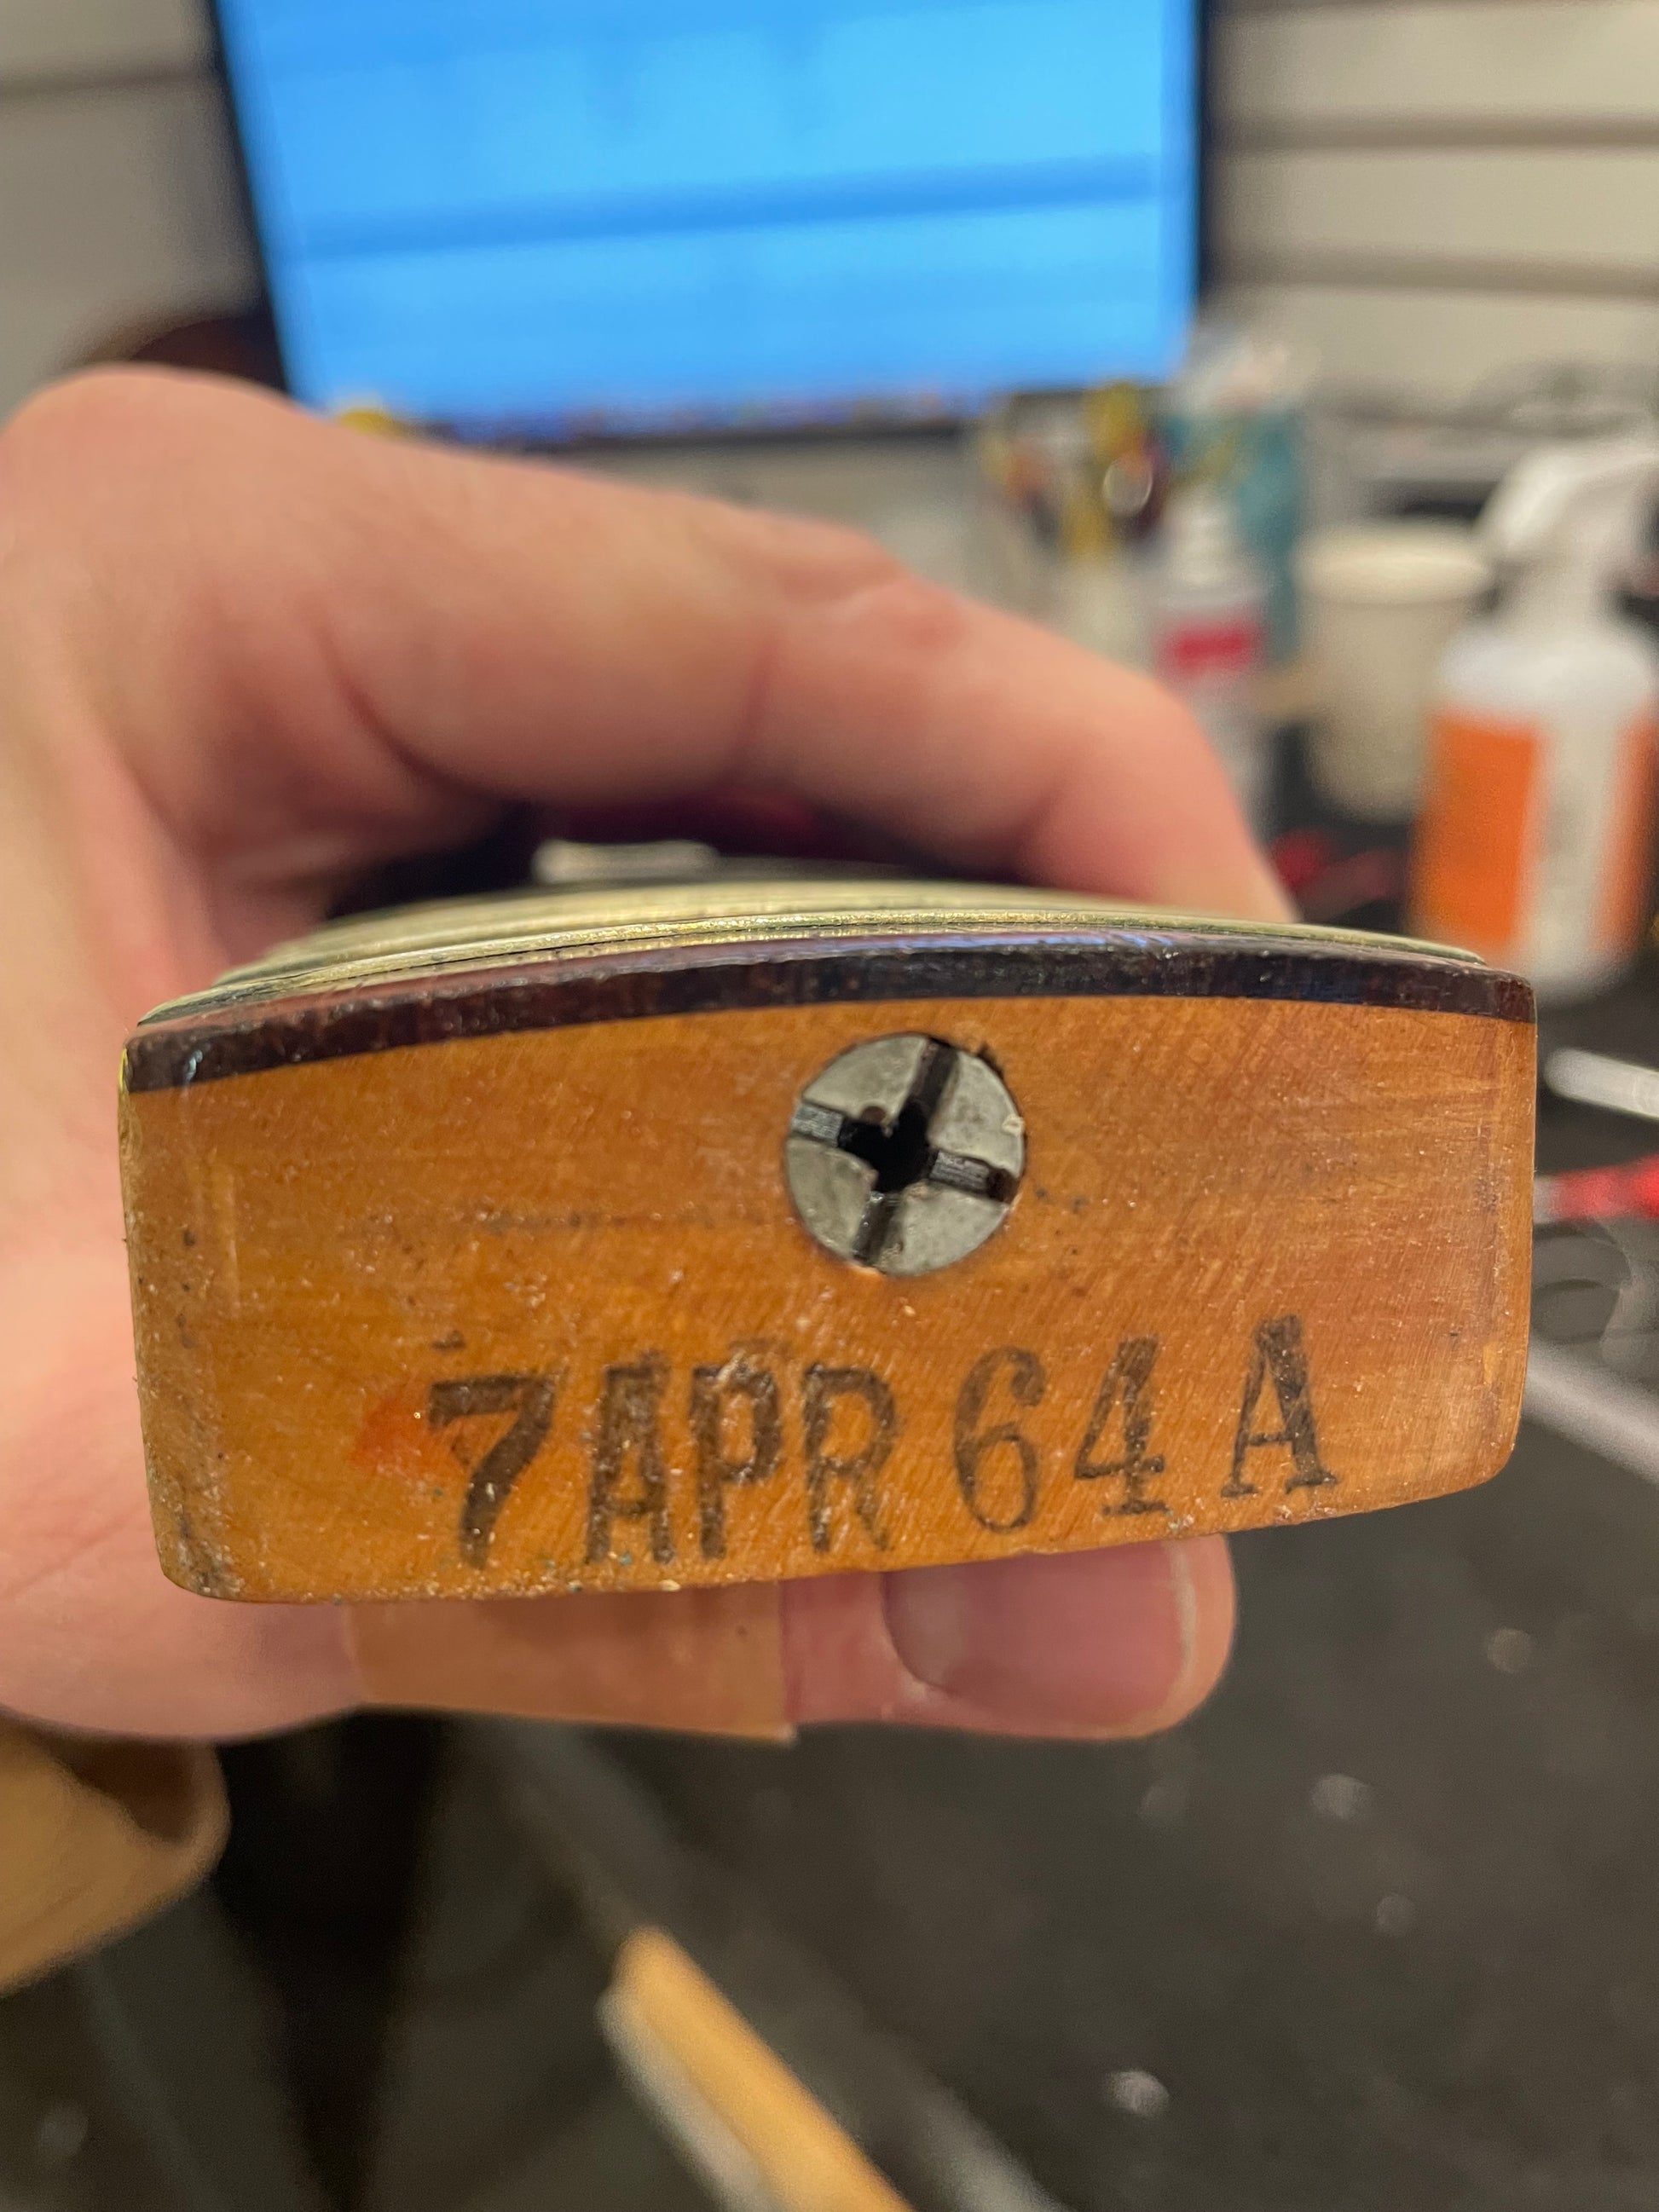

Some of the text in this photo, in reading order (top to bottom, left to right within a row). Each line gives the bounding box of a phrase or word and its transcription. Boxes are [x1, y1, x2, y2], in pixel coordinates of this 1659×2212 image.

[428, 1314, 1338, 1570] 7 APR 64 A
